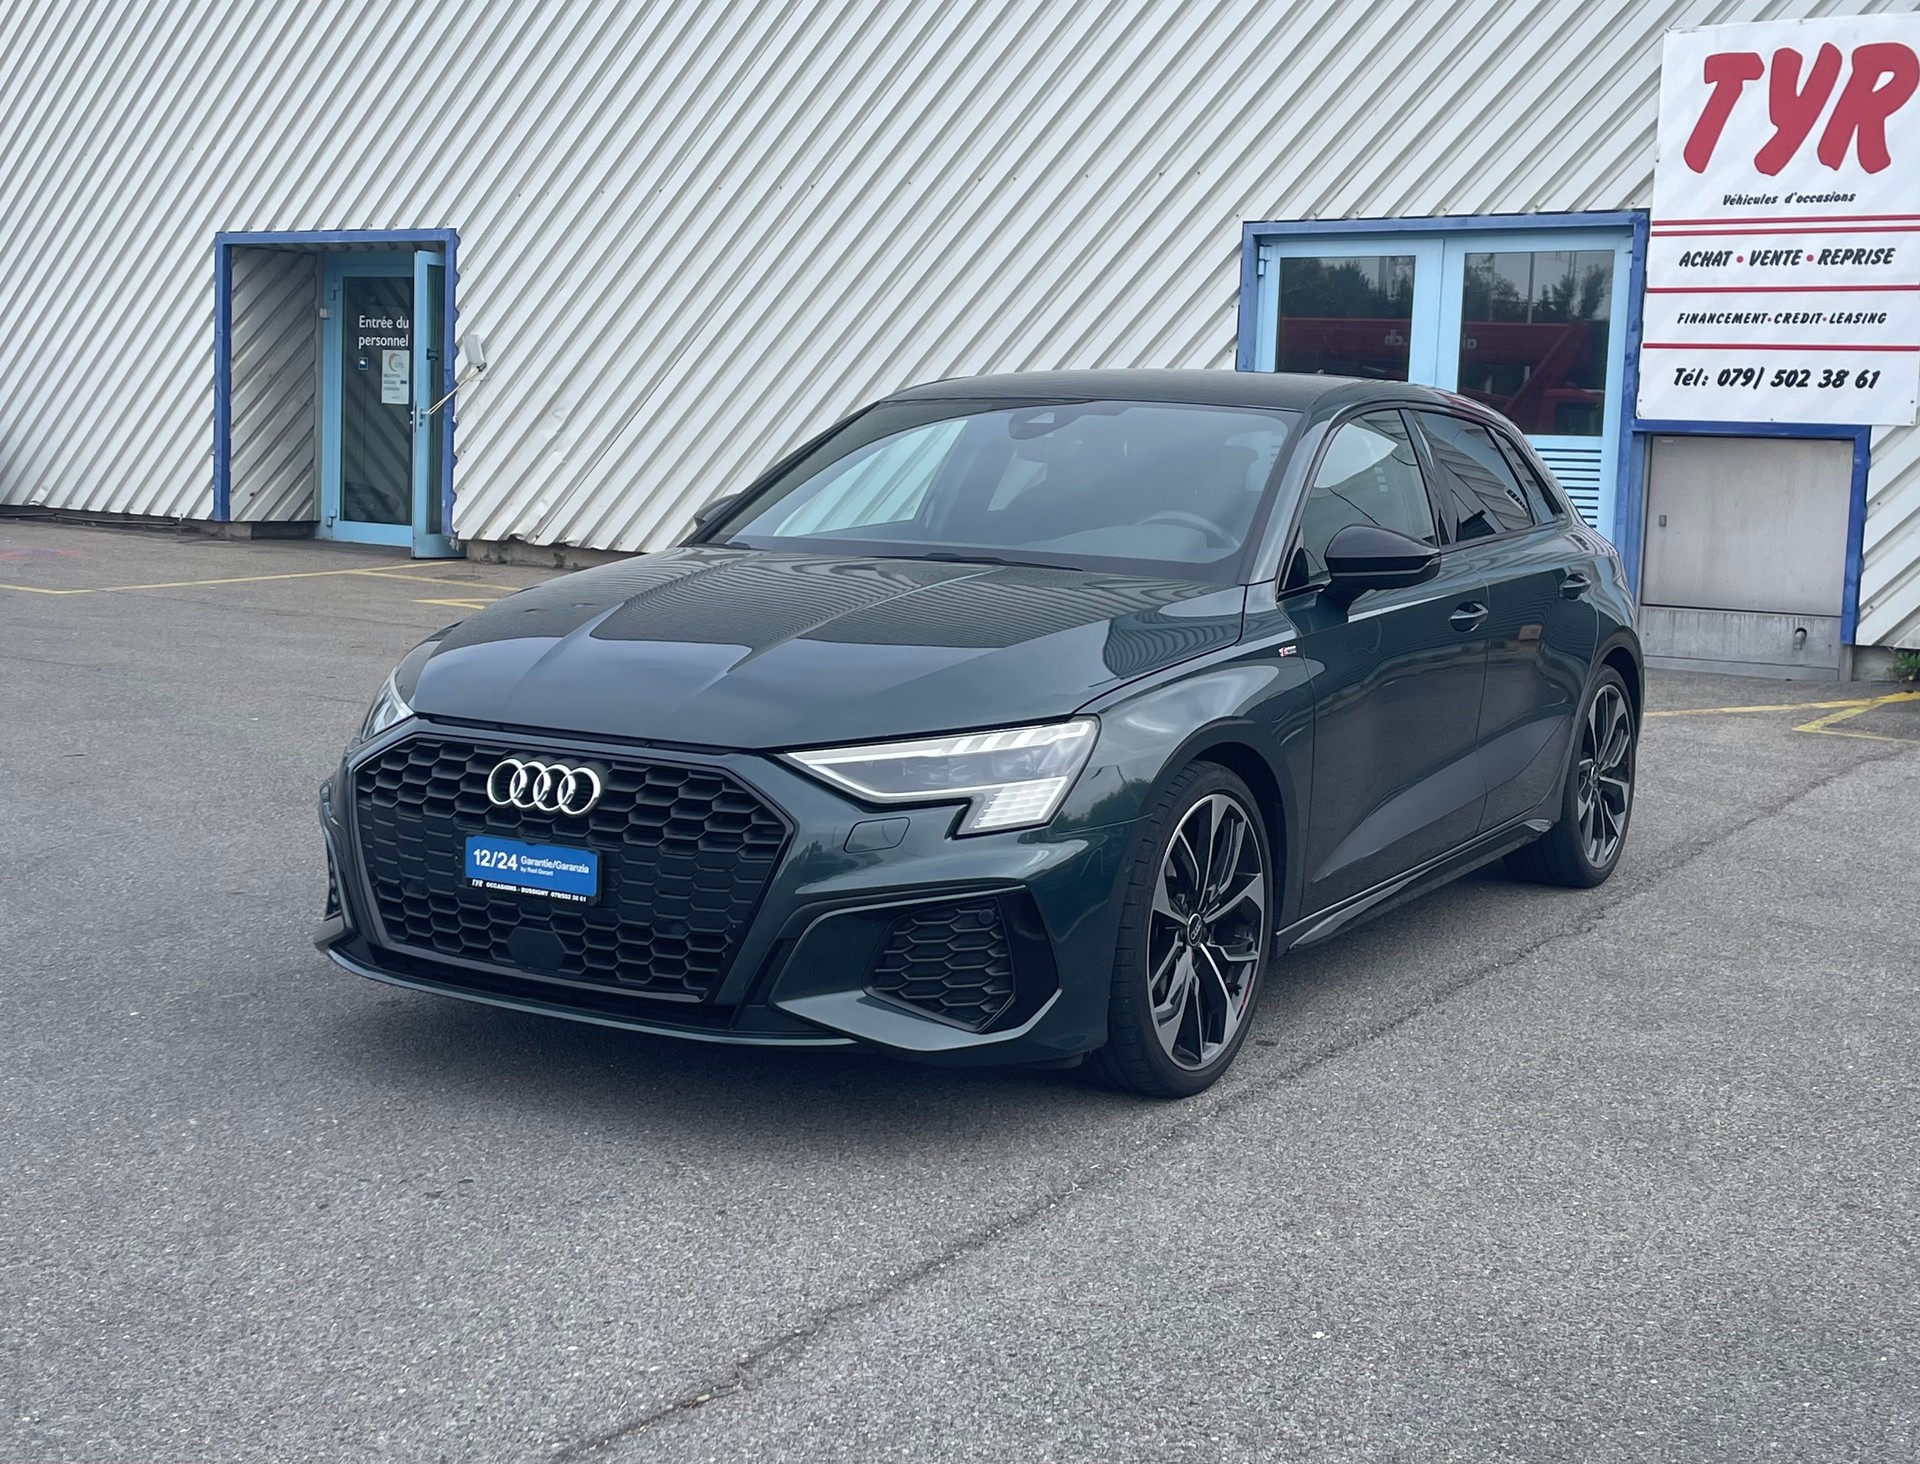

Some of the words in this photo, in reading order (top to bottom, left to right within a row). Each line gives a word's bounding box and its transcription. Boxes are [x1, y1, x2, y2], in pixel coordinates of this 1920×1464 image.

[1683, 42, 1920, 176] TYR
[1722, 193, 1779, 206] Véhicules
[1784, 191, 1857, 204] d'occasions
[1678, 250, 1734, 268] ACHAT
[1749, 249, 1804, 267] VENTE
[1817, 247, 1896, 266] REPRISE
[358, 315, 394, 329] Entrée
[396, 315, 410, 329] du
[1676, 312, 1769, 325] FINANCEMENT
[1773, 312, 1823, 325] CREDIT
[1828, 312, 1888, 325] LEASING
[358, 333, 409, 350] personnel
[1673, 367, 1710, 387] Tél:
[1769, 368, 1812, 388] 502
[1817, 368, 1850, 389] 38
[1854, 369, 1881, 389] 61
[473, 848, 518, 871] 12/24
[520, 855, 590, 874] Garantie/Garanzia
